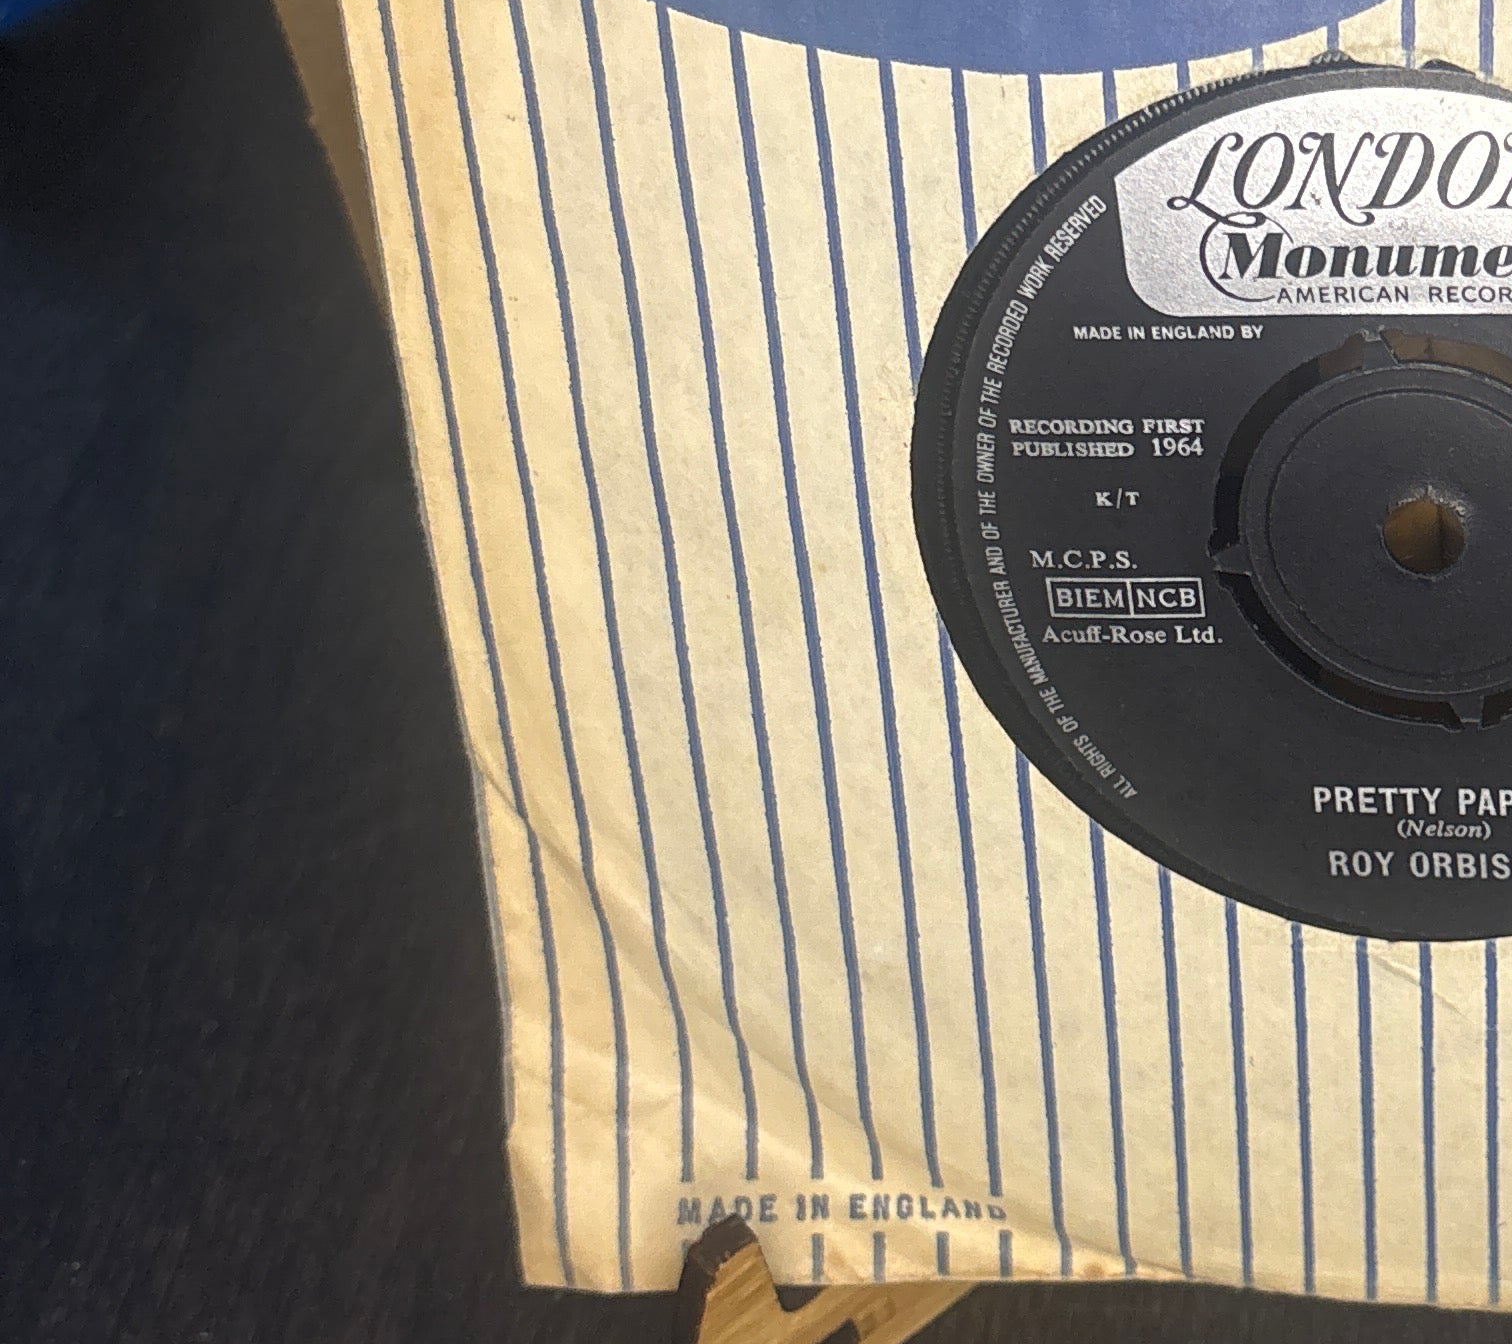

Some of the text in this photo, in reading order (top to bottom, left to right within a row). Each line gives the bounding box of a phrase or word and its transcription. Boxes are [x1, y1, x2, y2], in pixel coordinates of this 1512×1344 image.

[1276, 285, 1410, 304] AMERICAN
[1073, 325, 1263, 340] MADE IN ENGLAND BY
[1008, 418, 1205, 435] RECORDING FIRST
[1011, 437, 1204, 457] PUBLISHED 1964
[976, 194, 1138, 799] ALL RIGHTS OF THE MANUFACTURER AND OF THE OWNER OF THE RECORDED WORK RESERVED
[1029, 550, 1137, 569] M.C.P.S.
[1056, 588, 1196, 608] BIEM NCB
[1042, 625, 1223, 643] Acuff-Rose Ltd.
[1314, 786, 1441, 814] PRETTY
[1397, 819, 1491, 840] (Nelson)
[1329, 850, 1394, 877] ROY
[677, 1193, 1007, 1225] MADE IN ENGLAND
